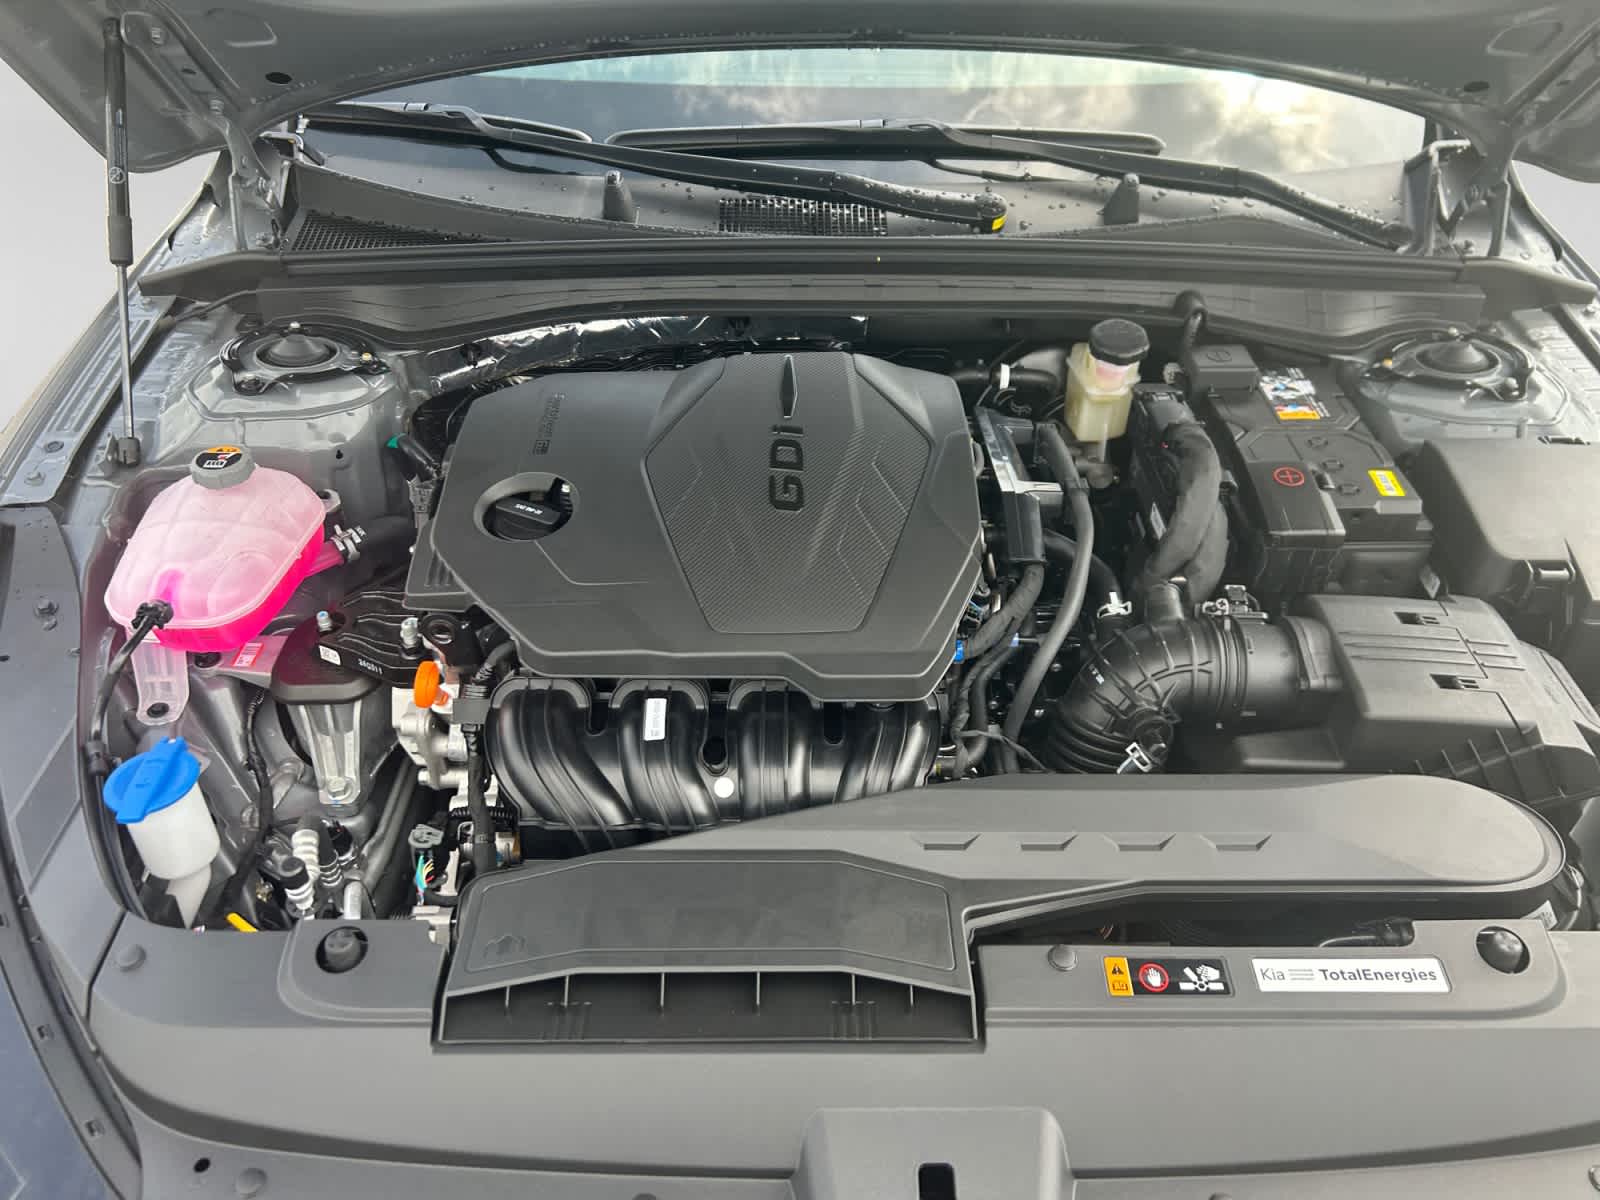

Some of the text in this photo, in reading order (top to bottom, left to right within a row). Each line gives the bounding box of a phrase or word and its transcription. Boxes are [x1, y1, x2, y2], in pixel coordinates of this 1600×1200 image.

[768, 424, 803, 512] GDi
[1260, 968, 1437, 983] Kia TotalEnergies
